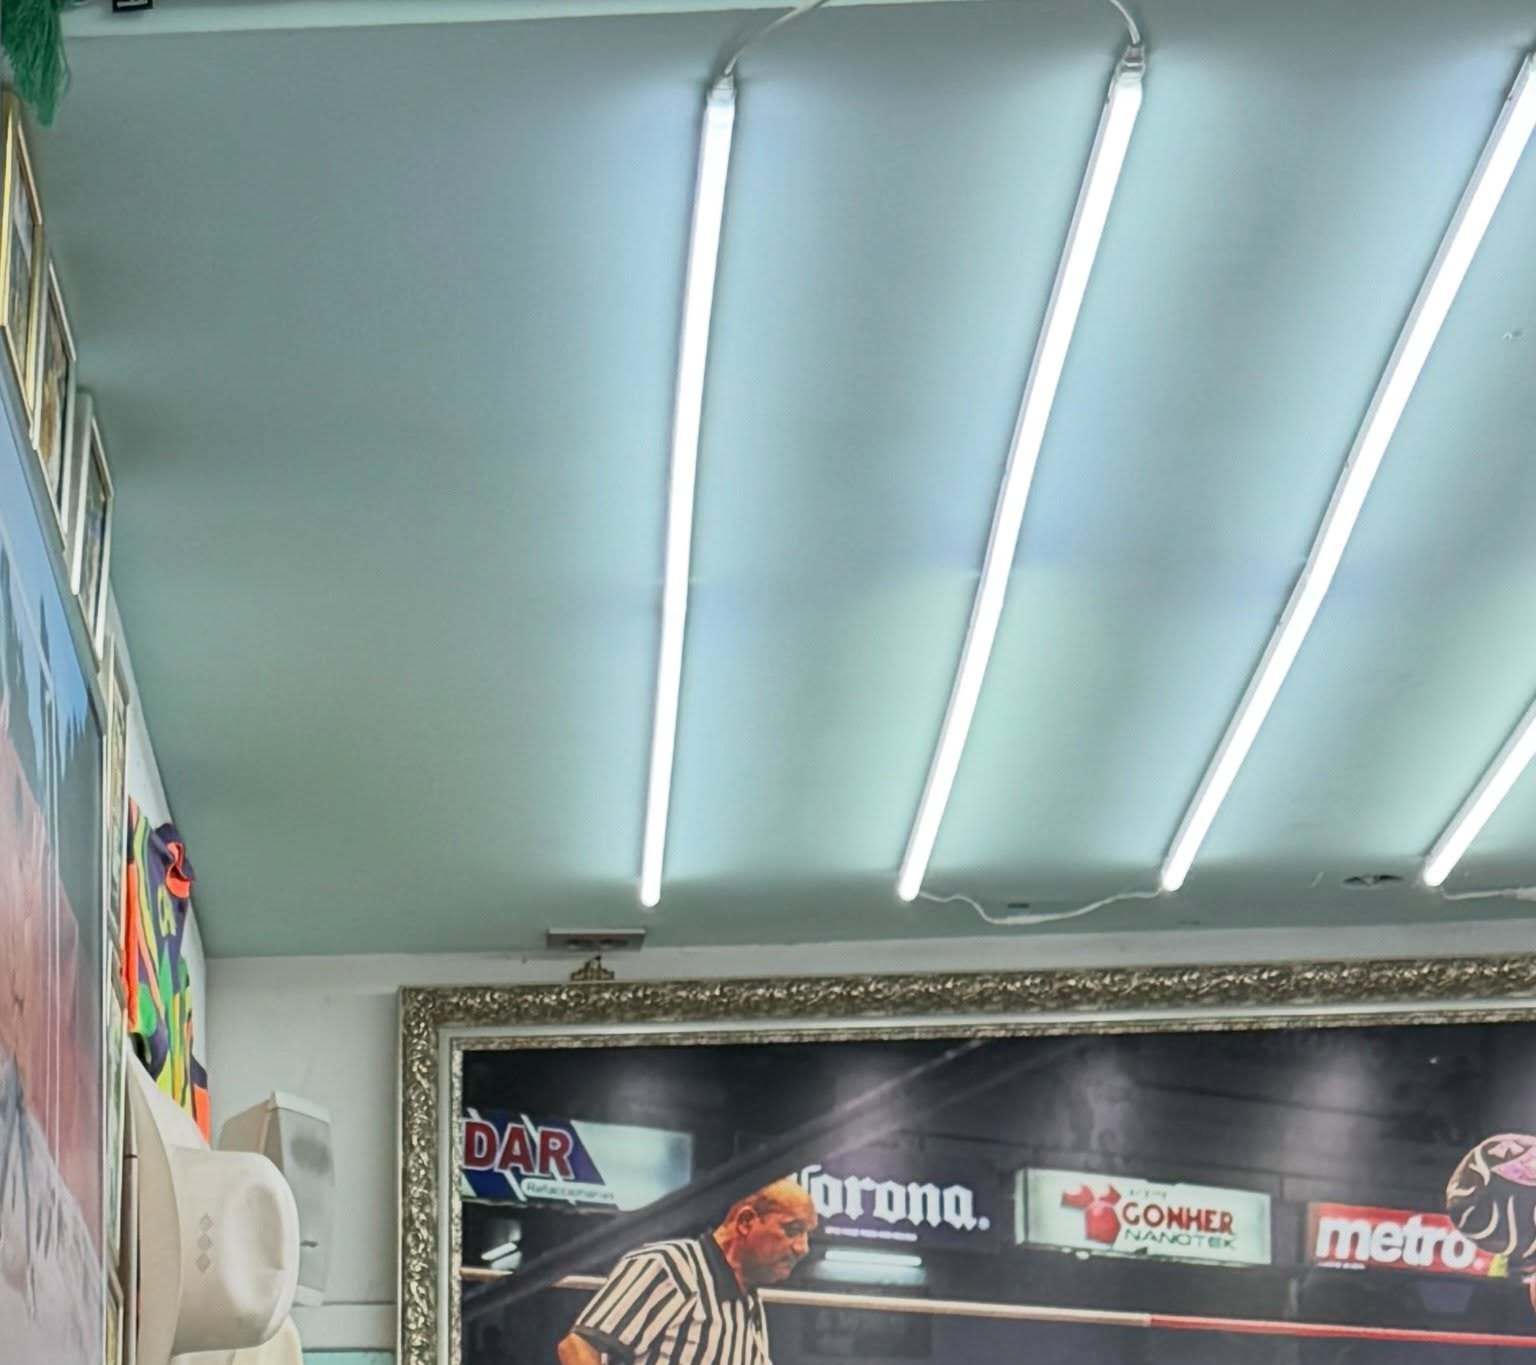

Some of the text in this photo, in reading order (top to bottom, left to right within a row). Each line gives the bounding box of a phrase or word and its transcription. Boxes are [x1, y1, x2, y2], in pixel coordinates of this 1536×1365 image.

[462, 1119, 574, 1181] DAR
[1121, 1202, 1234, 1234] GONHER
[1123, 1227, 1237, 1250] NANOTEK
